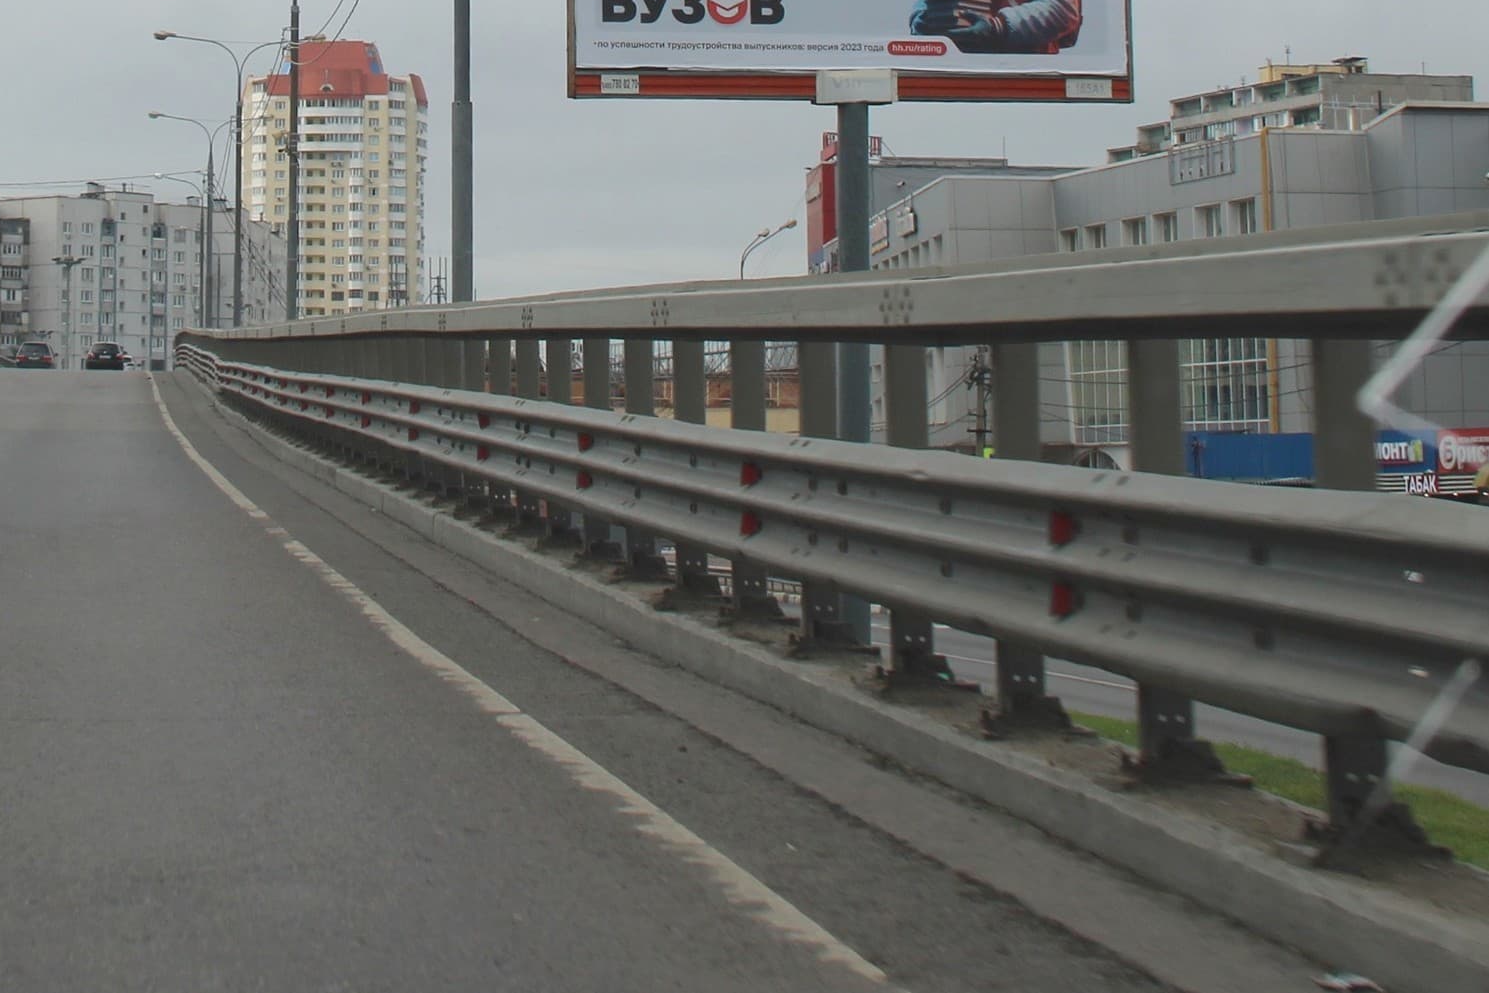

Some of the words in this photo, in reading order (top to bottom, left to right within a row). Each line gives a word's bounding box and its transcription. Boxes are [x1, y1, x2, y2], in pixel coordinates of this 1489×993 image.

[610, 41, 665, 50] успешности
[667, 41, 742, 51] трудоустройства
[807, 43, 839, 52] версия
[840, 43, 862, 51] 2023
[863, 44, 884, 53] года
[892, 43, 942, 54] hh.ru/rating
[1403, 475, 1438, 493] ТАБАК
